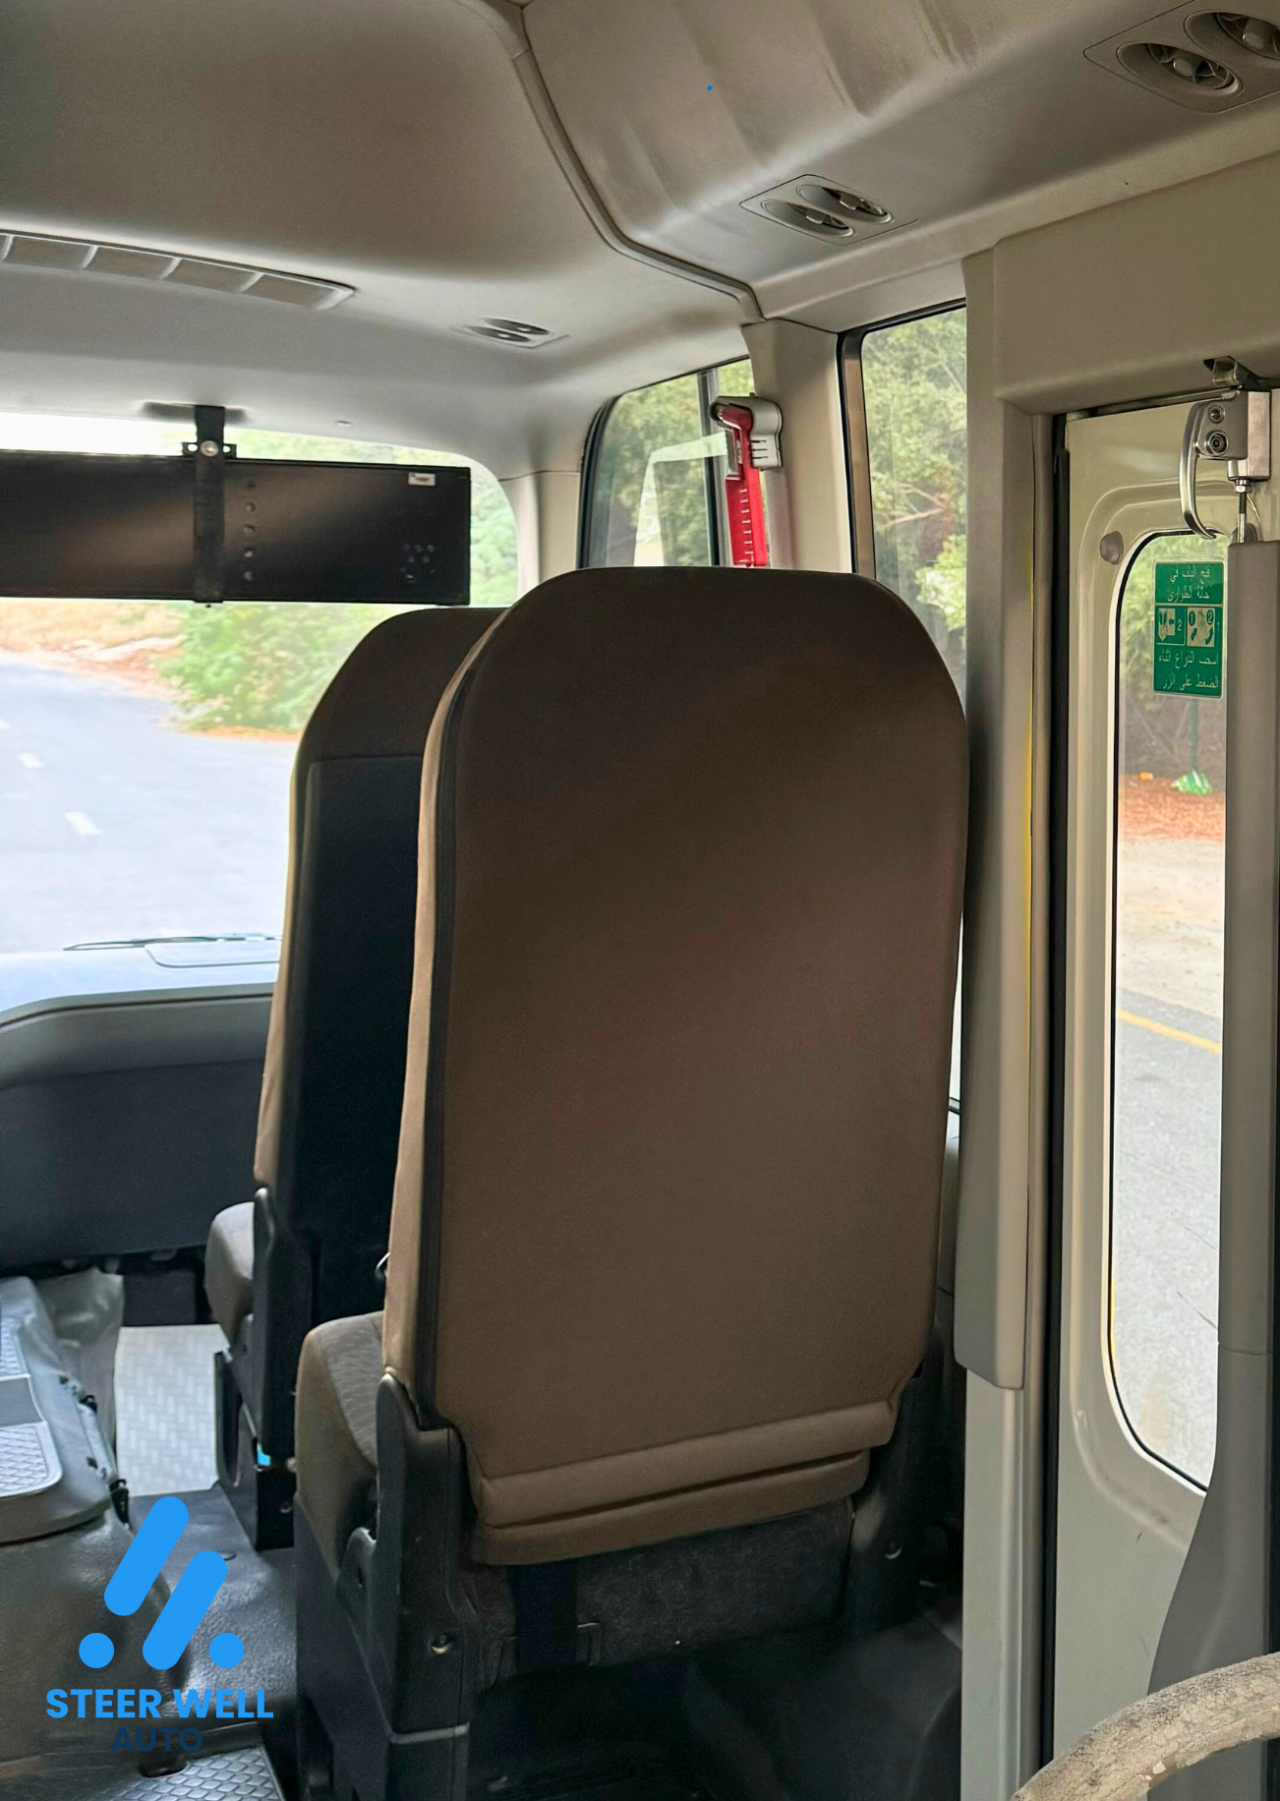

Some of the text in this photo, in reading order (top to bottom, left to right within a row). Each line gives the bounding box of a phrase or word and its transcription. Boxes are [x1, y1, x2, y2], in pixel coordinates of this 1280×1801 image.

[1170, 564, 1179, 584] في
[1177, 619, 1183, 631] 2
[1180, 673, 1192, 690] على
